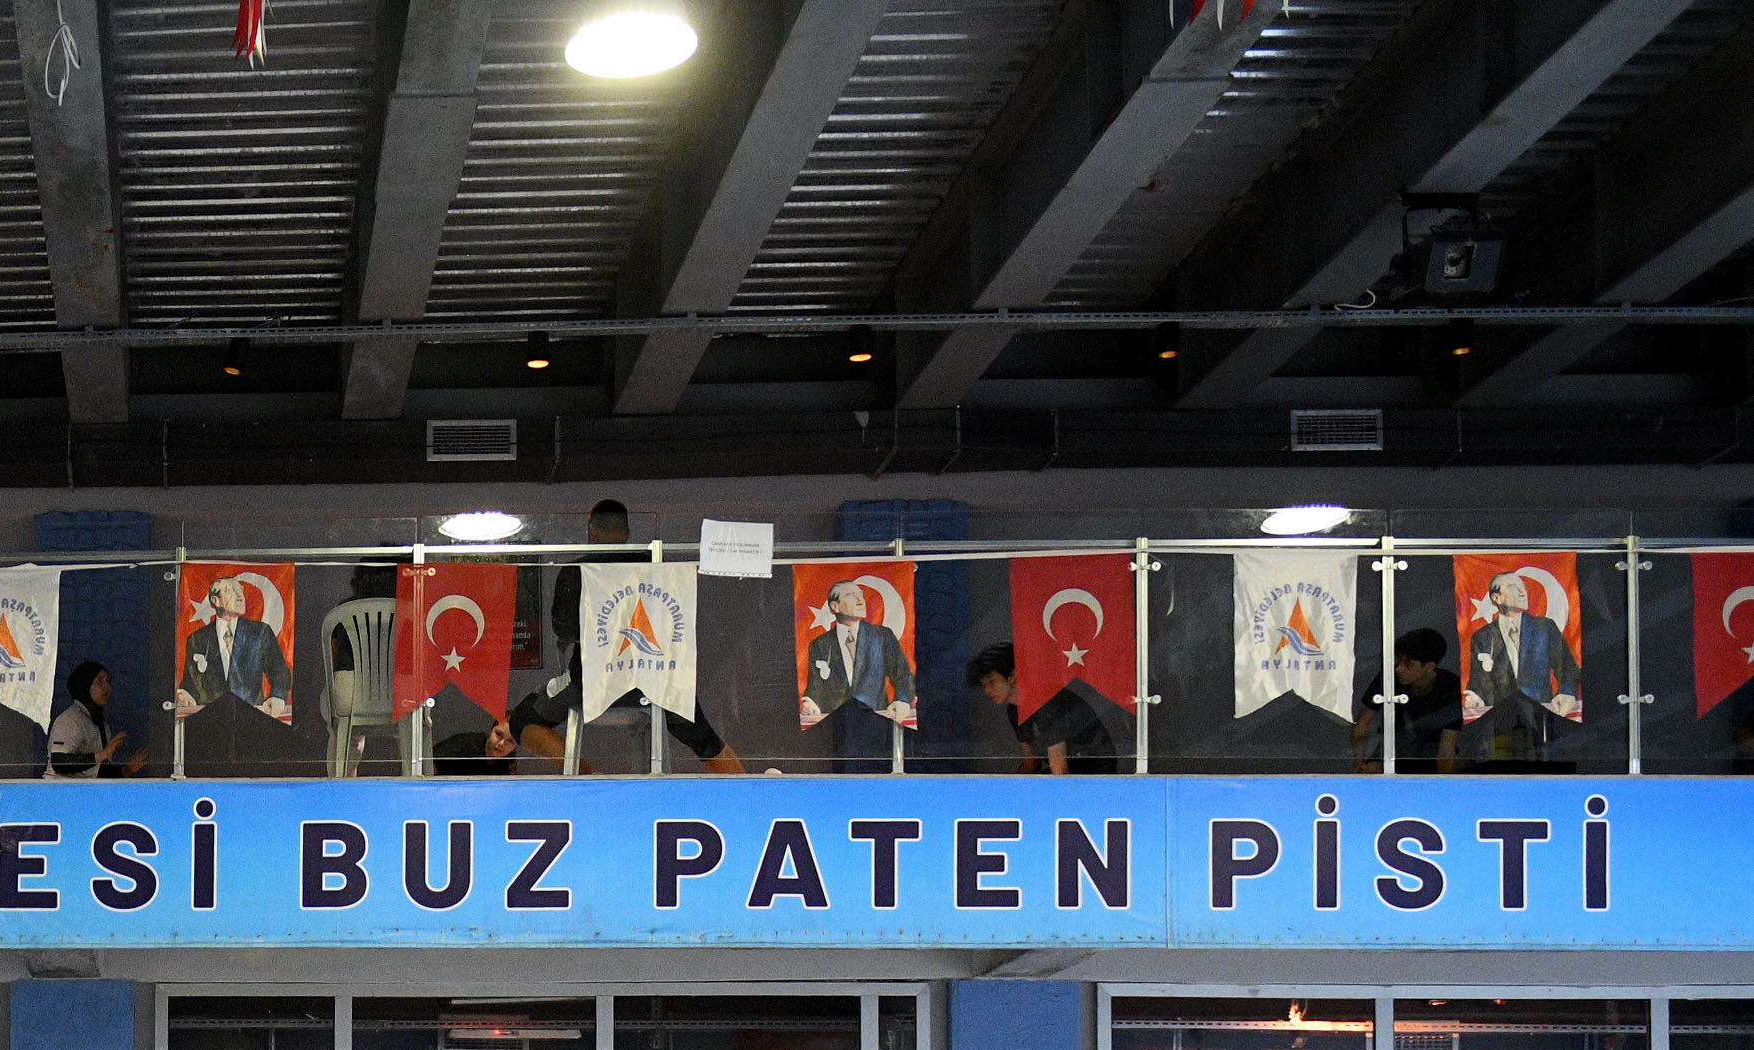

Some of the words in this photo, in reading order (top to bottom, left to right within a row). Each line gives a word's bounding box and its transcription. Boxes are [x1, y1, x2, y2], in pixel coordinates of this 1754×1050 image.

[300, 820, 573, 911] BUZ
[654, 818, 1131, 910] PATEN
[1209, 794, 1610, 912] PİSTİ
